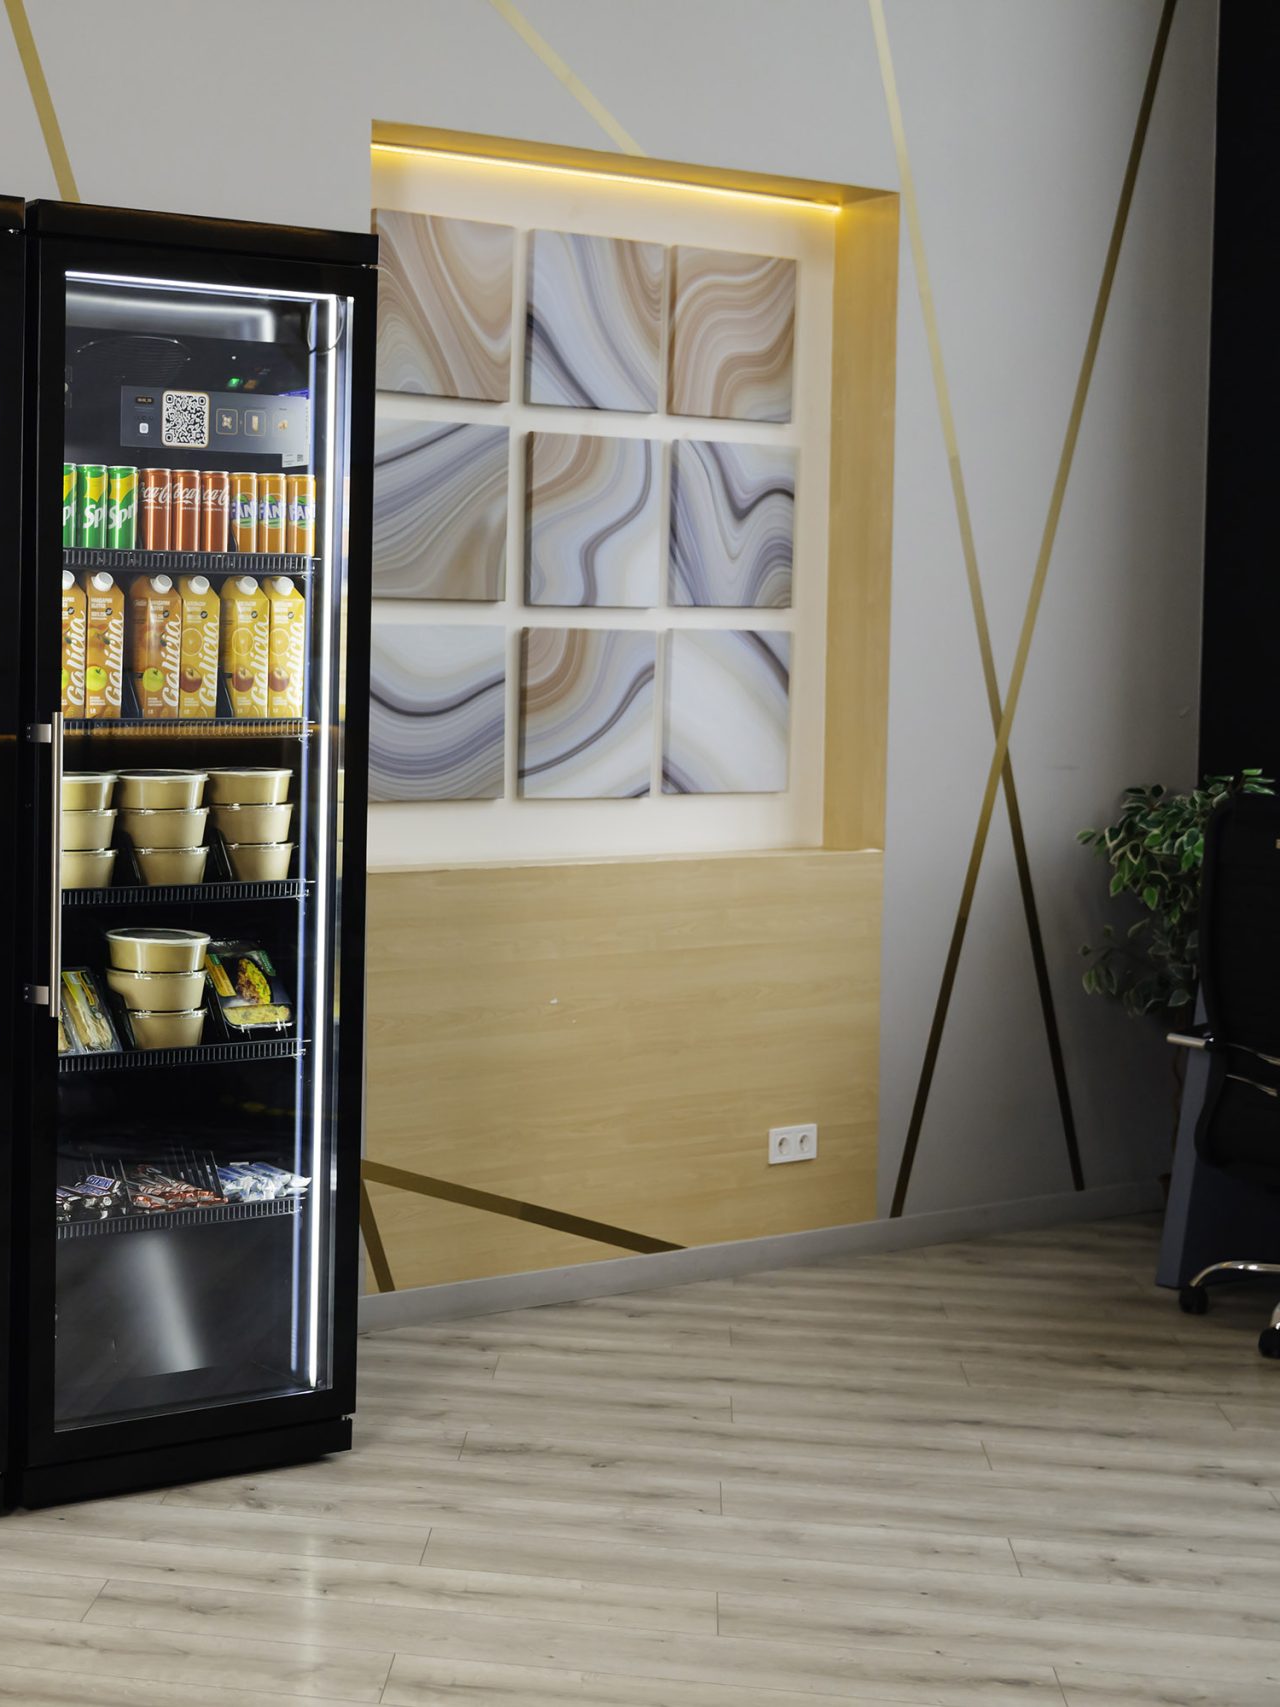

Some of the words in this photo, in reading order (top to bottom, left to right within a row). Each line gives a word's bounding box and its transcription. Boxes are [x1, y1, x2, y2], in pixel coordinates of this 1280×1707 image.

[104, 611, 123, 706] Galicia
[161, 614, 181, 707] Galicia
[199, 614, 219, 707] Galicia
[250, 614, 269, 706] Galicia
